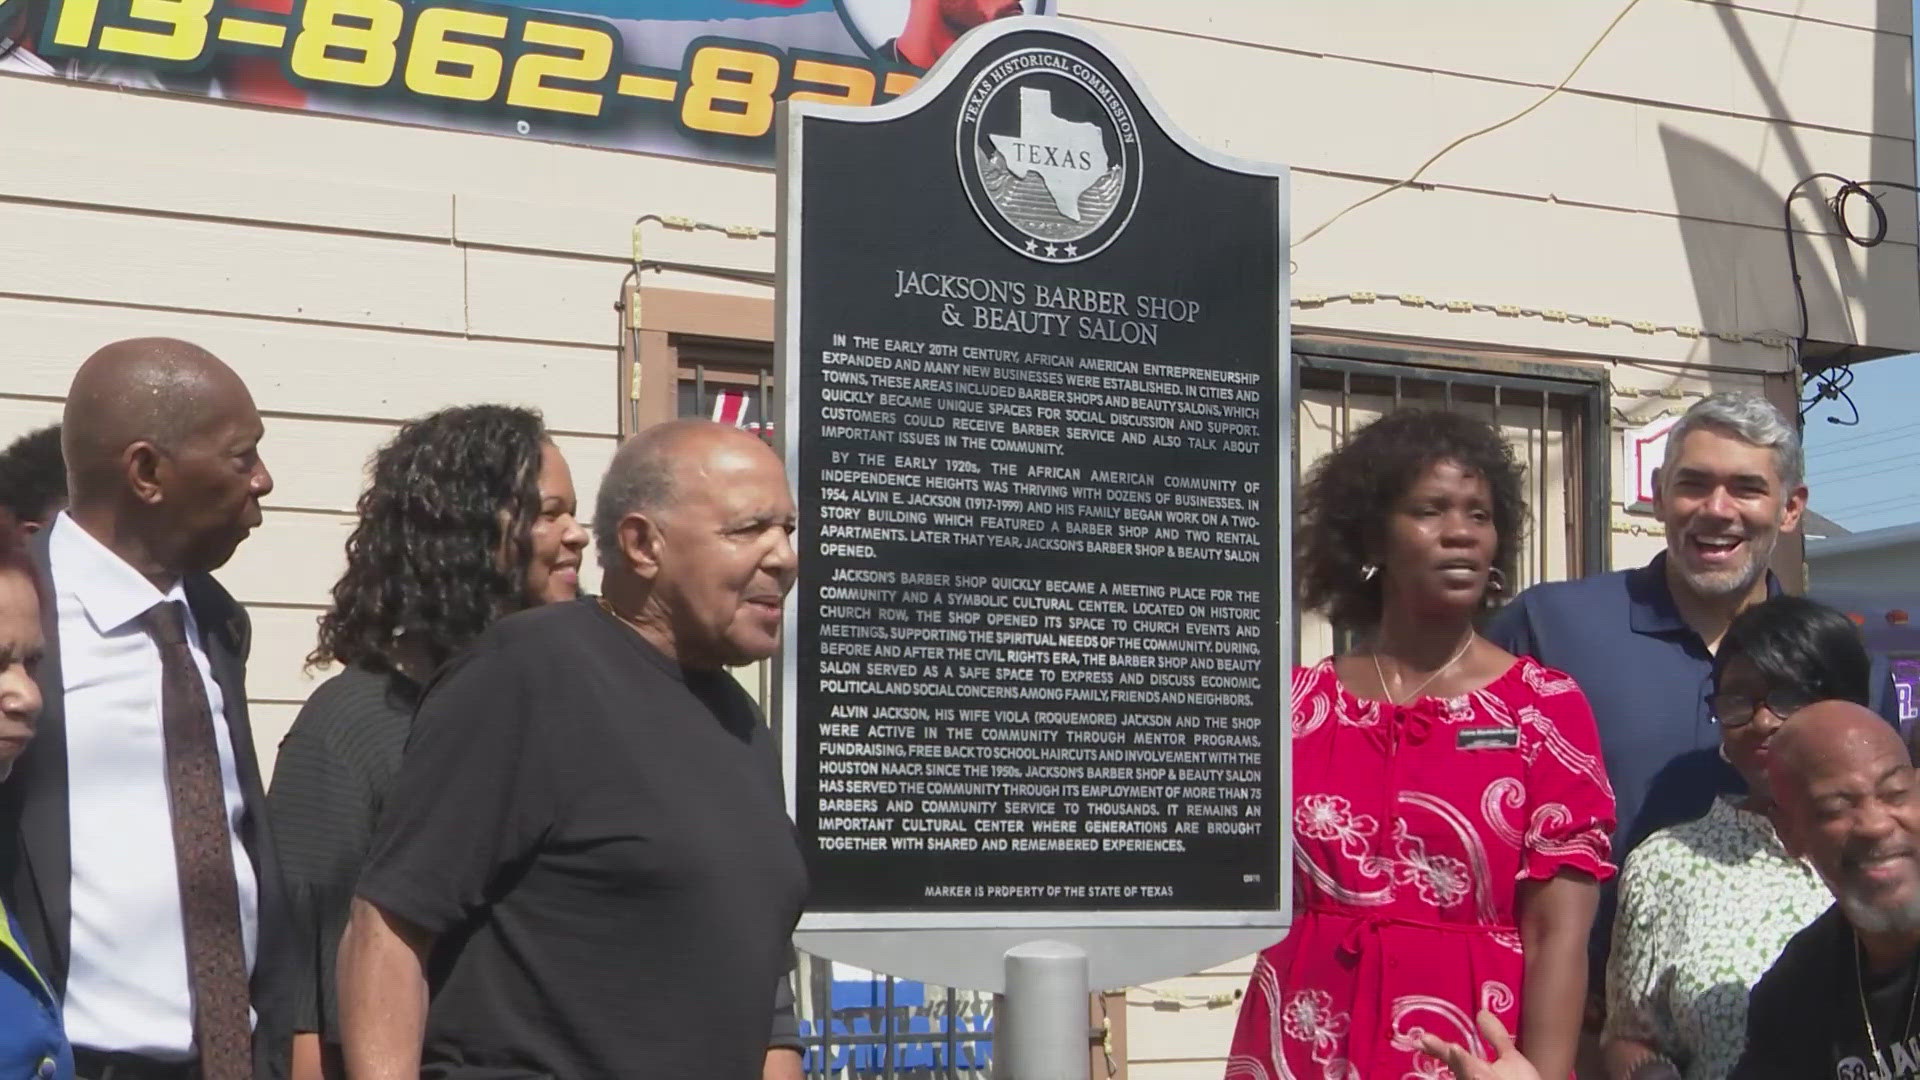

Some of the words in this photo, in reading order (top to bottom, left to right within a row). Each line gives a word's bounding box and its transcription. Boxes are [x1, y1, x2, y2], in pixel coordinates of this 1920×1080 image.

[964, 79, 993, 125] TEXAS
[990, 54, 1069, 83] HISTORICAL
[1072, 64, 1135, 144] COMMISSION
[1012, 142, 1092, 171] TEXAS
[895, 270, 1025, 305] JACKSON'S
[1035, 285, 1129, 316] BARBER
[1137, 296, 1200, 323] SHOP
[942, 304, 964, 327] &
[973, 306, 1071, 337] BEAUTY
[1078, 317, 1158, 346] SALON
[833, 334, 846, 346] IN
[853, 336, 879, 349] THE
[884, 339, 924, 353] EARLY
[928, 343, 957, 357] 20TH
[1024, 352, 1074, 367] AFRICAN
[1078, 357, 1138, 374] AMERICAN
[1143, 363, 1259, 385] ENTREPRENEURSHIP
[822, 351, 892, 369] EXPANDED
[894, 358, 921, 371] AND
[923, 361, 960, 374] MANY
[962, 364, 990, 377] NEW
[993, 367, 1063, 384] BUSINESSES
[1066, 374, 1100, 388] WERE
[1103, 377, 1182, 395] ESTABLISHED.
[1185, 384, 1196, 396] IN
[1199, 386, 1233, 399] CITIES
[1236, 389, 1259, 402] AND
[821, 388, 874, 404] QUICKLY
[879, 393, 931, 408] BECAME
[937, 398, 983, 413] UNIQUE
[988, 402, 1032, 417] SPACES
[1037, 406, 1061, 420] FOR
[1065, 409, 1104, 423] SOCIAL
[1110, 413, 1174, 429] DISCUSSION
[1179, 419, 1203, 431] AND
[1207, 421, 1258, 436] SUPPORT.
[831, 451, 849, 463] BY
[858, 453, 885, 466] THE
[894, 455, 937, 469] EARLY
[946, 459, 980, 473] 1920s,
[991, 462, 1017, 475] THE
[1027, 465, 1080, 480] AFRICAN
[1090, 470, 1154, 485] AMERICAN
[1164, 475, 1236, 491] COMMUNITY
[1243, 481, 1259, 493] OF
[821, 468, 920, 487] INDEPENDENCE
[925, 476, 979, 491] HEIGHTS
[982, 480, 1008, 492] WAS
[1012, 482, 1067, 497] THRIVING
[1072, 486, 1102, 499] WITH
[1106, 489, 1151, 503] DOZENS
[1155, 492, 1170, 504] OF
[1174, 494, 1243, 509] BUSINESSES.
[1248, 499, 1259, 510] IN
[820, 505, 860, 520] STORY
[867, 509, 927, 524] BUILDING
[933, 513, 973, 527] WHICH
[980, 516, 1044, 531] FEATURED
[1051, 521, 1059, 532] A
[1065, 522, 1112, 535] BARBER
[1118, 525, 1148, 538] SHOP
[1154, 527, 1179, 539] AND
[1185, 529, 1210, 541] TWO
[1216, 531, 1259, 545] RENTAL
[820, 543, 876, 558] OPENED.
[831, 568, 895, 583] JACKSON'S
[900, 572, 950, 586] BARBER
[955, 575, 987, 588] SHOP
[991, 577, 1041, 591] QUICKLY
[1045, 580, 1094, 593] BECAME
[1099, 582, 1107, 594] A
[1112, 583, 1165, 597] MEETING
[1169, 587, 1205, 599] PLACE
[1210, 589, 1232, 601] FOR
[1236, 590, 1259, 602] THE
[819, 605, 871, 619] CHURCH
[878, 608, 908, 621] ROW,
[916, 610, 941, 622] THE
[948, 611, 980, 624] SHOP
[986, 613, 1037, 627] OPENED
[1044, 616, 1062, 628] ITS
[1068, 617, 1105, 630] SPACE
[1112, 619, 1127, 631] TO
[1133, 620, 1179, 633] CHURCH
[1186, 622, 1230, 636] EVENTS
[1236, 625, 1260, 637] AND
[819, 661, 860, 674] SALON
[866, 663, 917, 676] SERVED
[923, 665, 938, 677] AS
[944, 666, 953, 677] A
[959, 666, 990, 679] SAFE
[995, 667, 1033, 680] SPACE
[1039, 669, 1055, 681] TO
[1061, 670, 1113, 683] EXPRESS
[1119, 672, 1144, 684] AND
[1150, 673, 1195, 686] DISCUSS
[830, 705, 868, 718] ALVIN
[872, 706, 930, 720] JACKSON,
[935, 708, 954, 720] HIS
[959, 709, 989, 721] WIFE
[994, 710, 1029, 723] VIOLA
[1034, 711, 1116, 725] (ROQUEMORE)
[1121, 713, 1171, 726] JACKSON
[1175, 716, 1200, 727] AND
[1204, 716, 1227, 728] THE
[1231, 717, 1261, 729] SHOP
[819, 723, 858, 736] WERE
[868, 725, 915, 738] ACTIVE
[924, 727, 937, 738] IN
[946, 727, 972, 739] THE
[981, 728, 1058, 741] COMMUNITY
[1066, 730, 1125, 743] THROUGH
[1133, 732, 1185, 744] MENTOR
[1193, 734, 1260, 746] PROGRAMS,
[819, 798, 878, 811] BARBERS
[886, 800, 913, 812] AND
[921, 800, 996, 813] COMMUNITY
[1004, 801, 1055, 814] SERVICE
[1063, 802, 1079, 814] TO
[1087, 802, 1159, 815] THOUSANDS.
[1167, 804, 1178, 815] IT
[1186, 804, 1237, 816] REMAINS
[1245, 805, 1261, 816] AN
[818, 817, 893, 830] IMPORTANT
[902, 818, 966, 831] CULTURAL
[974, 819, 1024, 832] CENTER
[1032, 820, 1076, 832] WHERE
[1084, 820, 1167, 833] GENERATIONS
[1174, 822, 1199, 833] ARE
[1207, 822, 1261, 834] BROUGHT
[818, 837, 887, 849] TOGETHER
[891, 837, 923, 849] WITH
[927, 838, 977, 850] SHARED
[981, 838, 1007, 850] AND
[1011, 838, 1098, 851] REMEMBERED
[1102, 839, 1185, 851] EXPERIENCES.
[925, 885, 971, 898] MARKER
[974, 885, 984, 898] IS
[987, 885, 1044, 898] PROPERTY
[1047, 885, 1061, 898] OF
[1064, 885, 1085, 898] THE
[1088, 885, 1120, 898] STATE
[1123, 885, 1137, 898] OF
[1140, 885, 1174, 898] TEXAS
